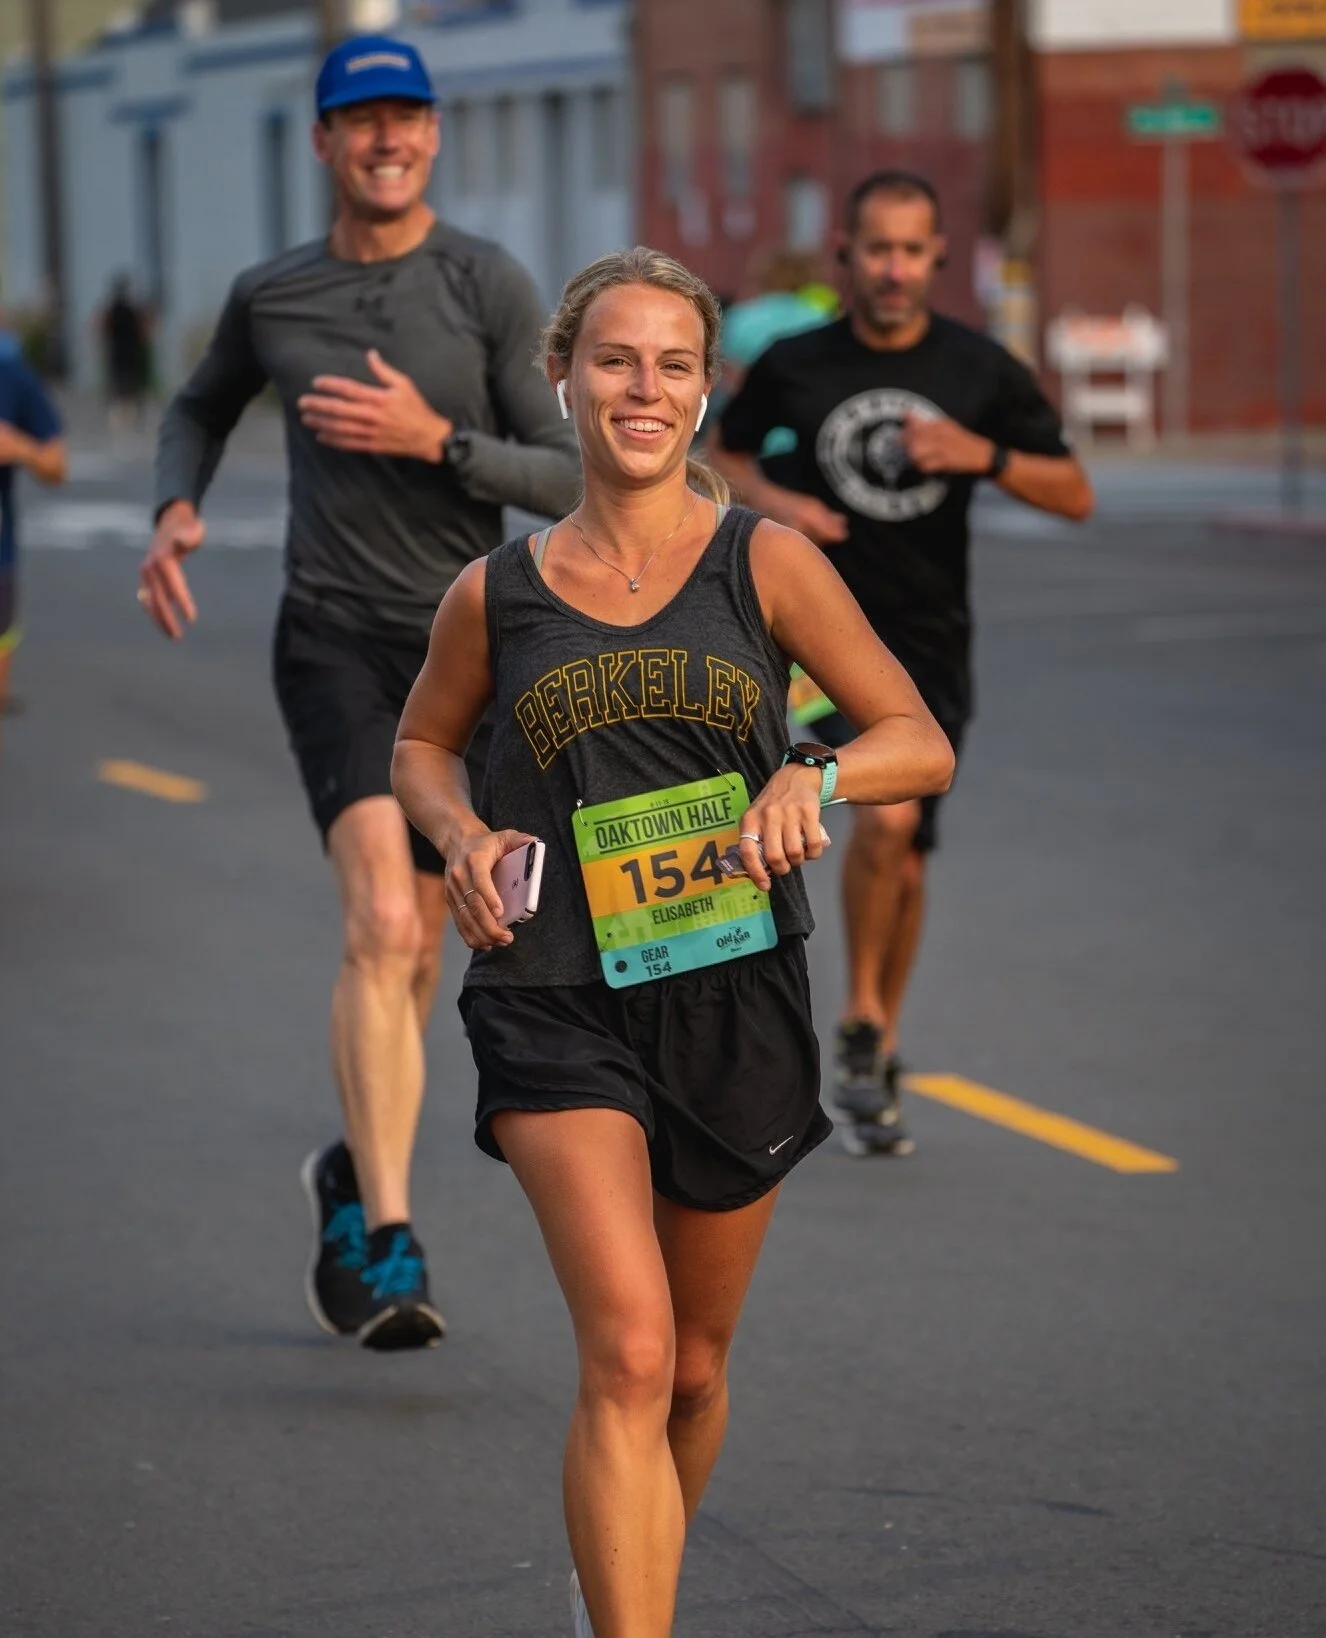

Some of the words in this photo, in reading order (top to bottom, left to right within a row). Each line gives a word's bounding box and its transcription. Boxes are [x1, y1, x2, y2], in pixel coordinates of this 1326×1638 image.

[514, 648, 761, 770] BERKELEY
[595, 808, 683, 850] OAKTOWN
[688, 797, 731, 828] HALF
[619, 840, 724, 905] 154
[652, 895, 716, 925] ELISABETH
[641, 945, 669, 964] GEAR
[646, 961, 672, 977] 154
